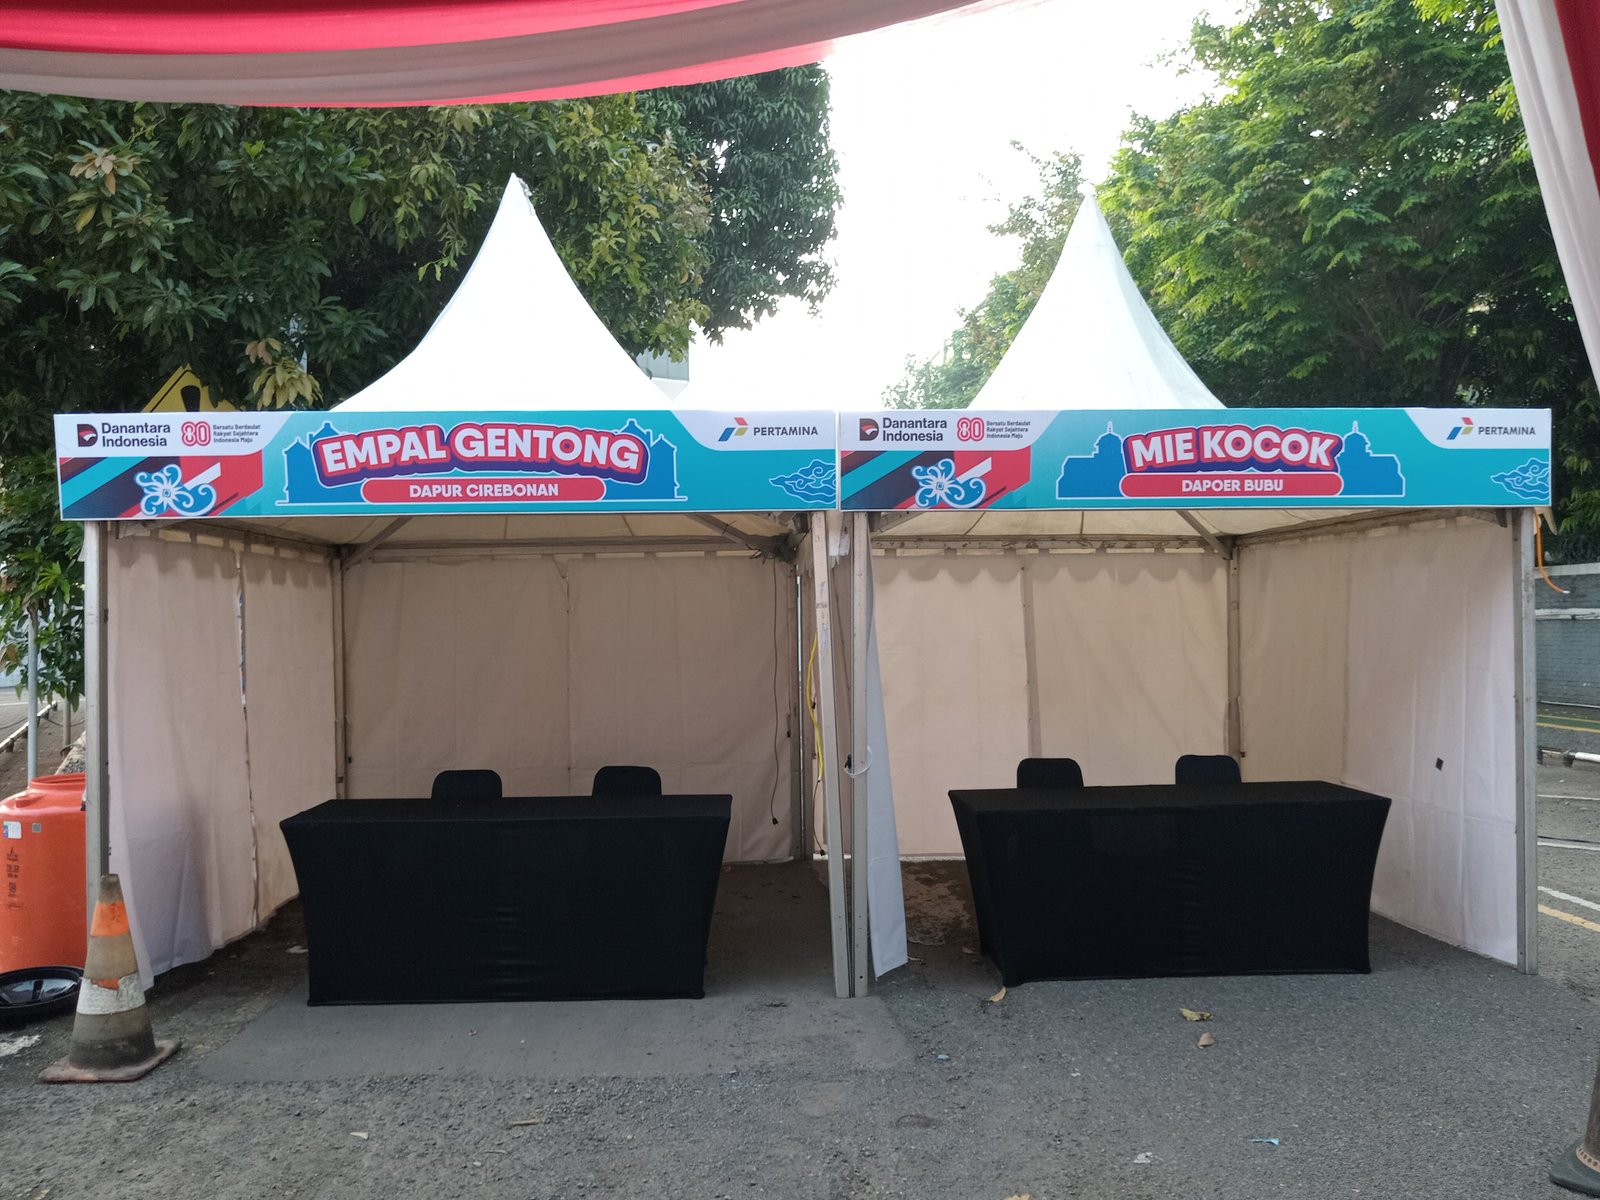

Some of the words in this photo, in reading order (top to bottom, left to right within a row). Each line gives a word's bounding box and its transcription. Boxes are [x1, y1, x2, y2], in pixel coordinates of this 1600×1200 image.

[101, 422, 171, 434] Danantara
[882, 417, 948, 429] Danantara
[181, 421, 211, 447] 80
[753, 426, 819, 436] PERTAMINA
[957, 417, 984, 442] 80
[1478, 426, 1536, 435] PERTAMINA
[102, 435, 168, 447] Indonesia
[882, 430, 944, 442] Indonesia
[321, 429, 447, 473] EMPAL
[454, 427, 640, 470] GENTONG
[1131, 432, 1194, 468] MIE
[1203, 429, 1335, 467] KOCOK
[409, 484, 463, 498] DAPUR
[466, 483, 559, 497] CIREBONAN
[1182, 479, 1241, 492] DAPOER
[1243, 479, 1284, 492] BUBU
